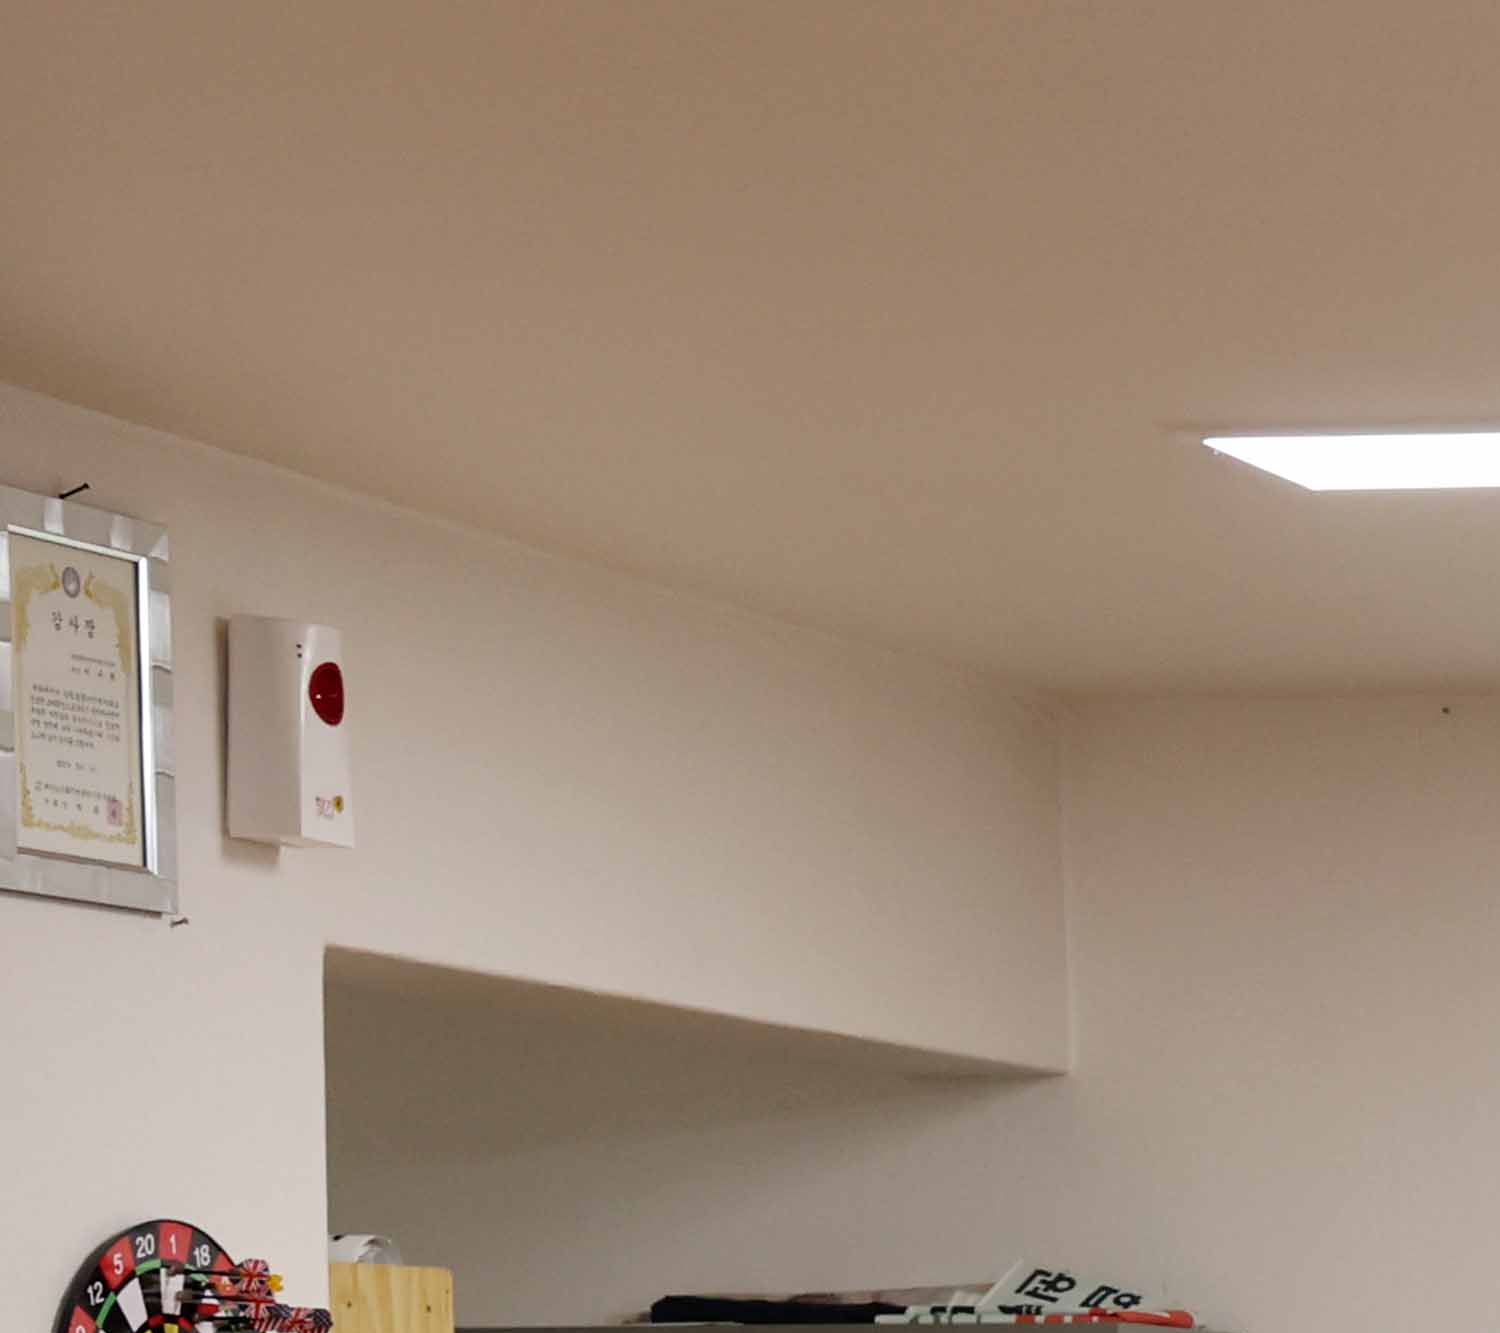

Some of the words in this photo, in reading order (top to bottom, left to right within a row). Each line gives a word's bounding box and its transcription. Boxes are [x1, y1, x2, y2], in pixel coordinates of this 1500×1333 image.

[135, 1233, 155, 1258] 20
[169, 1234, 176, 1254] 1
[193, 1244, 211, 1267] 18
[113, 1252, 124, 1275] 5
[87, 1281, 105, 1306] 12
